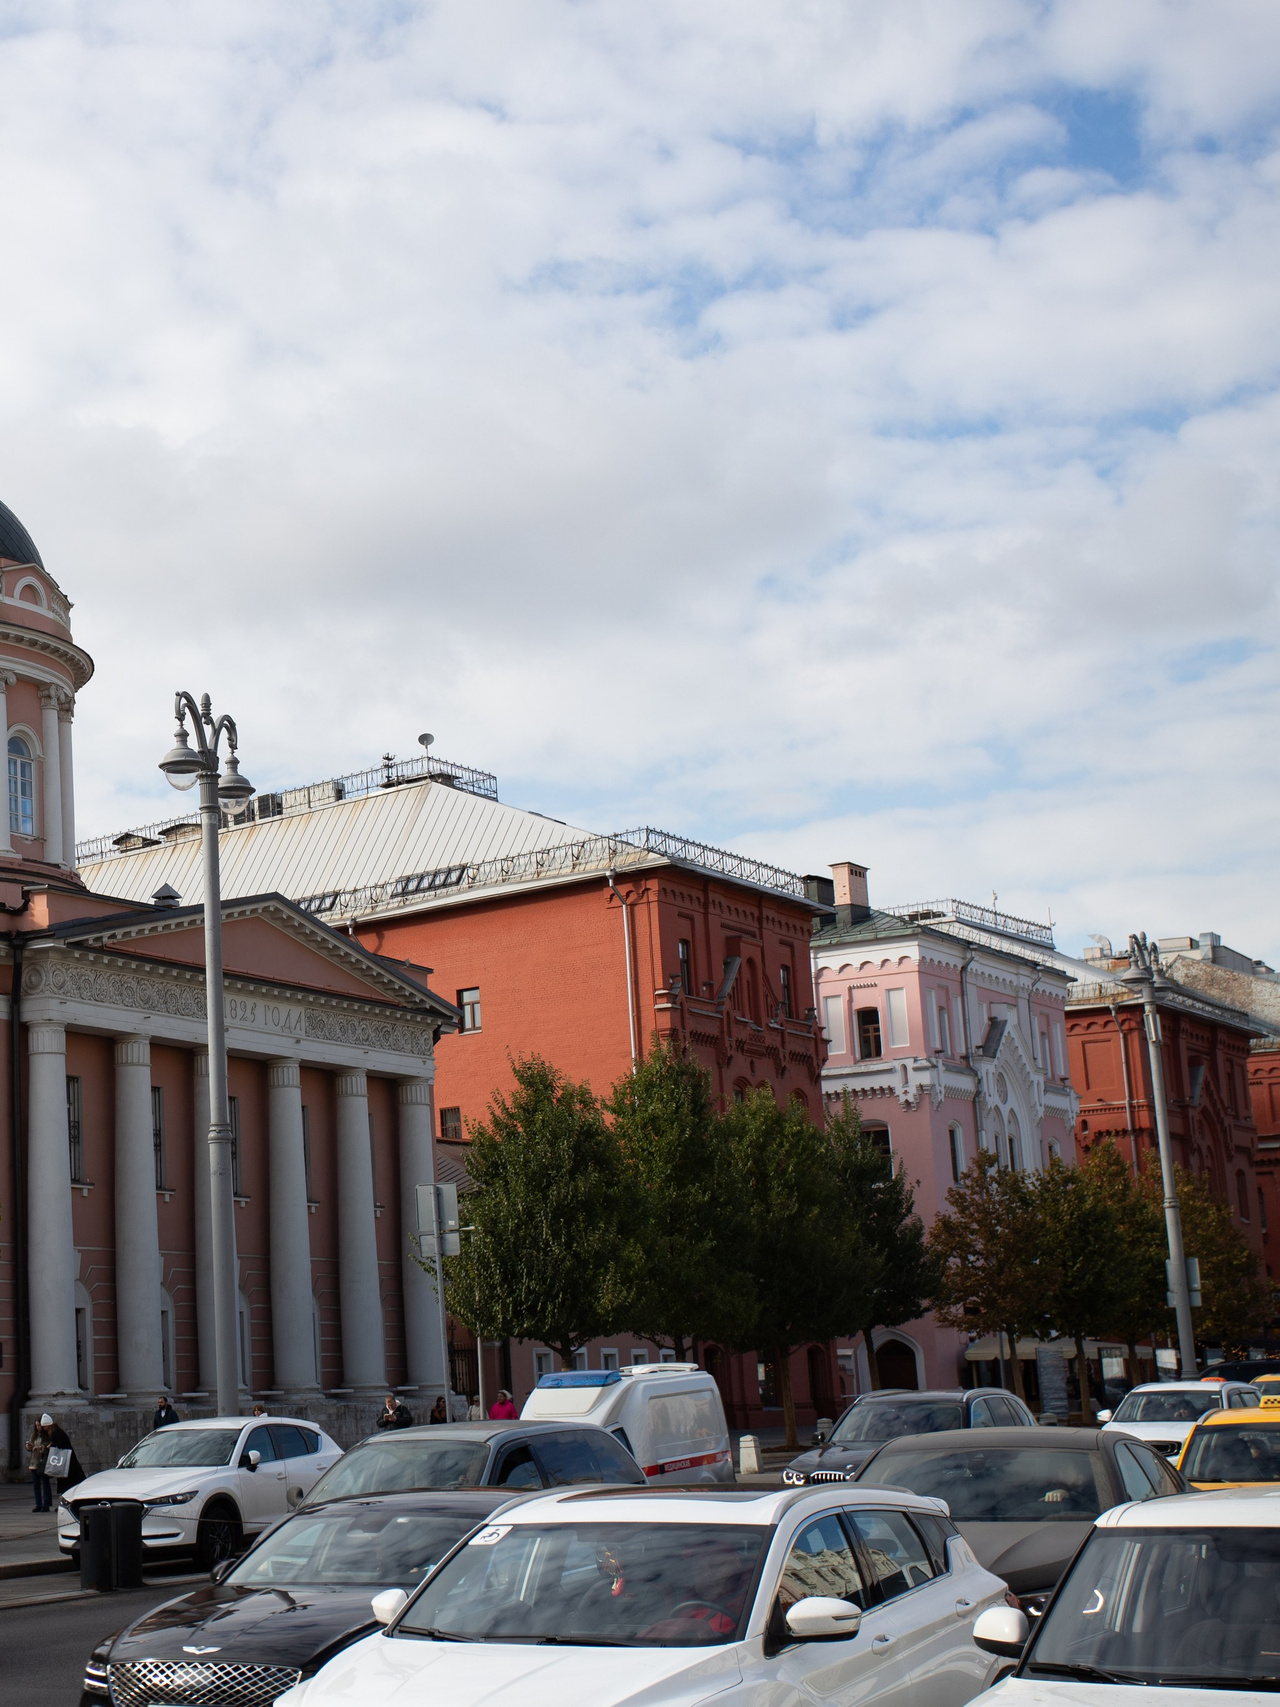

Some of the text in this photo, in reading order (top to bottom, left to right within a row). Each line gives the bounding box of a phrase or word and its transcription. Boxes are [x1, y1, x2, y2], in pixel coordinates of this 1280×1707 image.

[223, 997, 303, 1034] 1825 ГОДА
[49, 1455, 64, 1467] GJ
